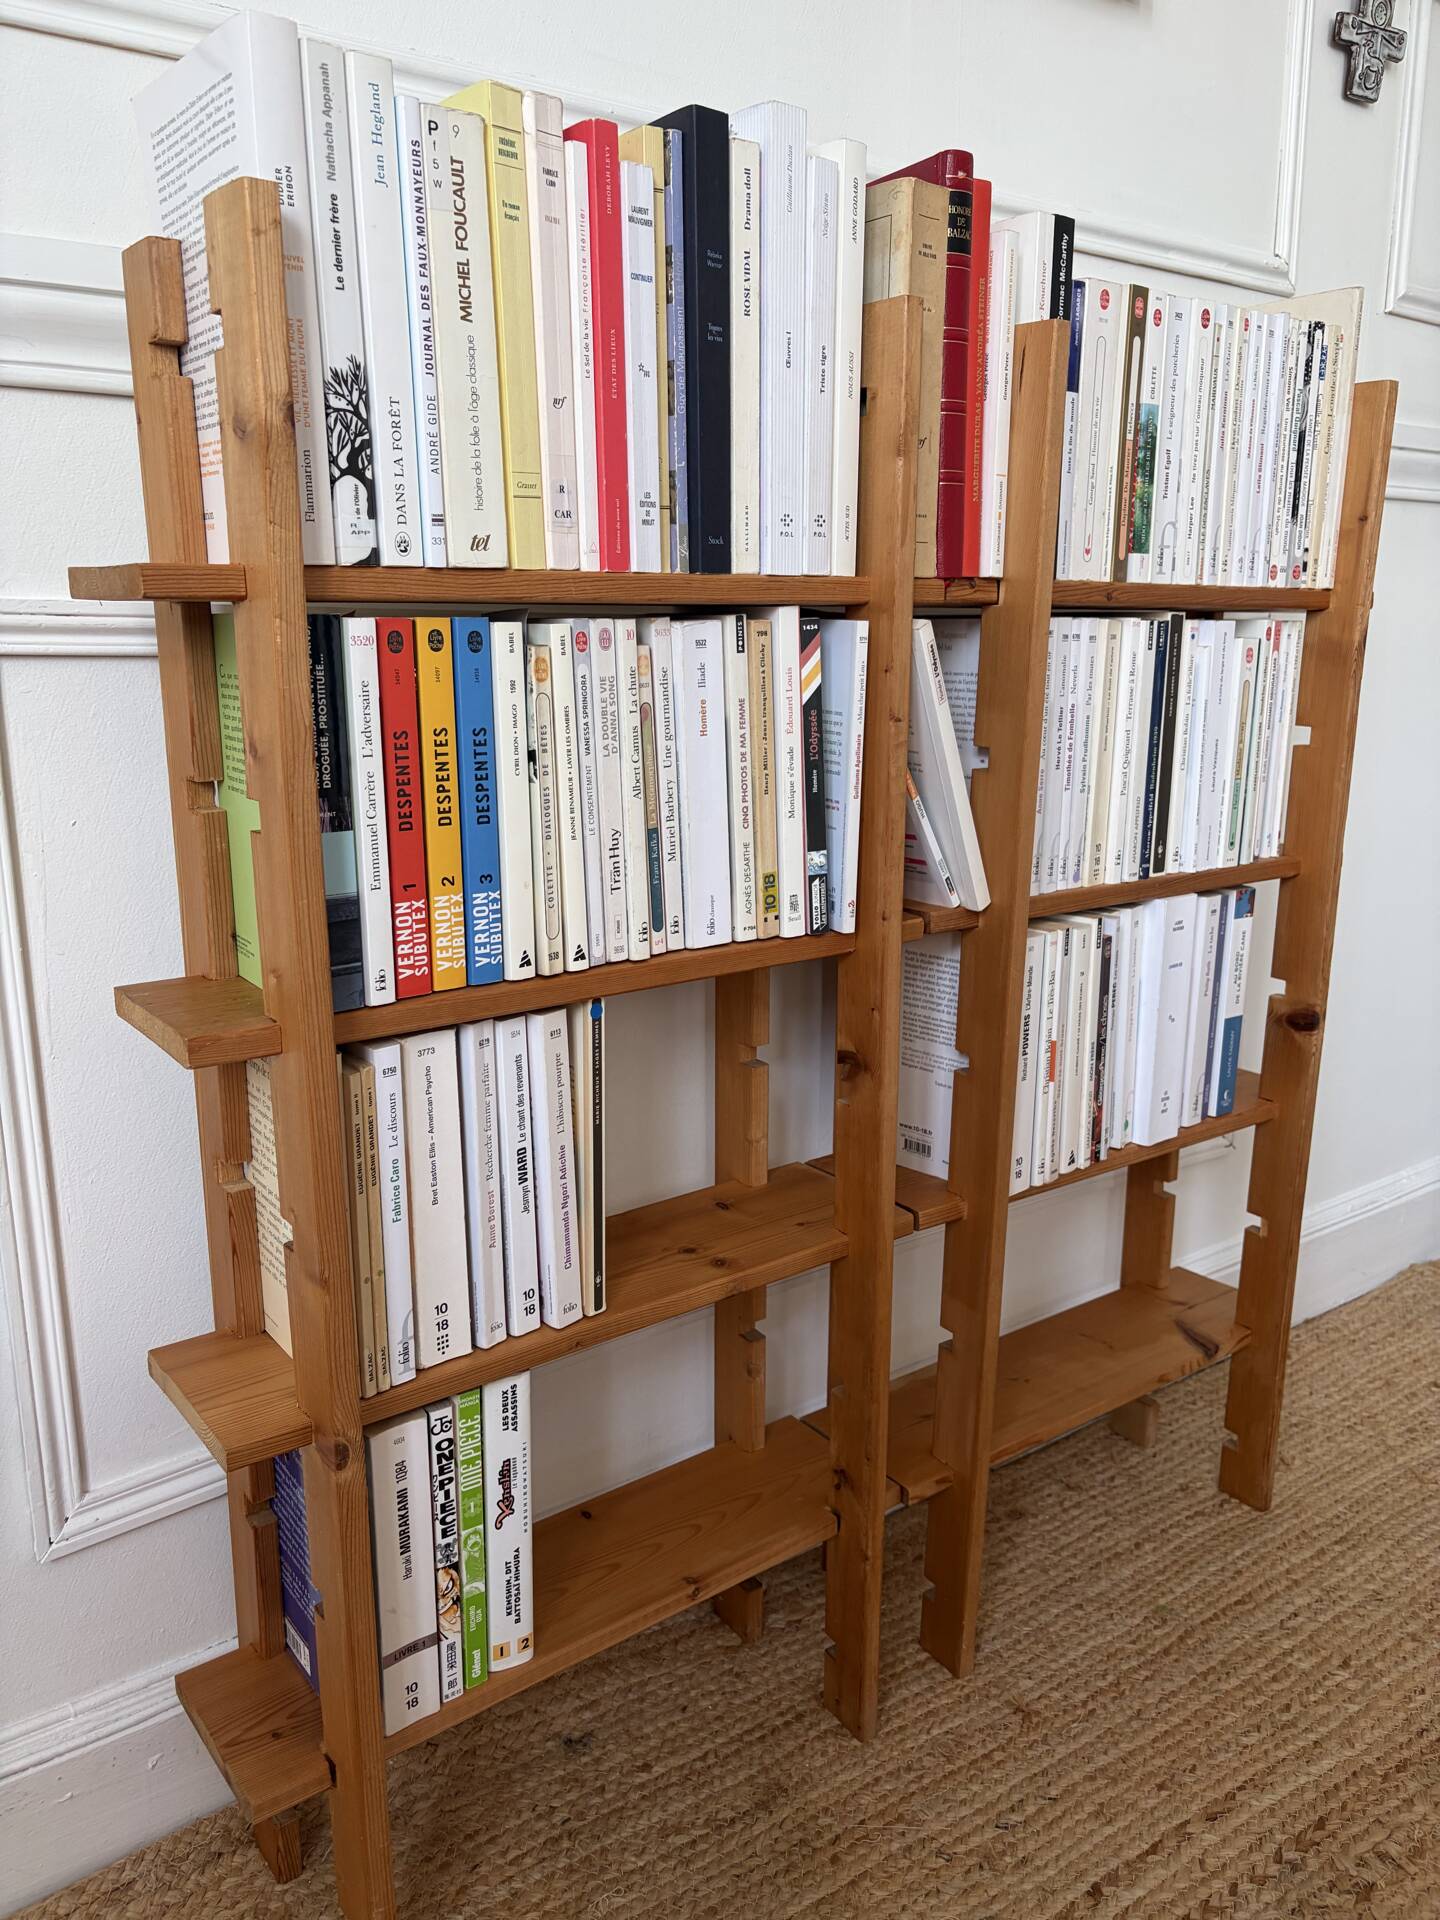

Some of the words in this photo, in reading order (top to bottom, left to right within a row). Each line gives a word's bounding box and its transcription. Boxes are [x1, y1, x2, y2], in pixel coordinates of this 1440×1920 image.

[319, 63, 333, 118] Appanah
[369, 82, 384, 146] Hegland
[323, 122, 337, 181] Nathacha
[285, 165, 295, 207] ERIBON
[374, 155, 388, 188] Jean
[329, 194, 340, 223] frère
[411, 139, 428, 278] FAUX-MONNAYEURS
[450, 156, 469, 251] FOUCAULT
[331, 228, 344, 272] dernier
[743, 248, 751, 282] VIDAL
[1059, 233, 1069, 281] McCarthy
[335, 276, 344, 290] Le
[420, 285, 431, 310] DES
[457, 258, 473, 323] MICHEL
[580, 258, 589, 313] Françoise
[743, 285, 751, 317] ROSE
[421, 317, 434, 377] JOURNAL
[583, 332, 589, 340] la
[583, 342, 590, 352] de
[675, 306, 686, 373] Maupassant
[465, 334, 478, 384] classique
[583, 354, 591, 367] Sel
[584, 369, 591, 379] Le
[677, 377, 685, 390] de
[426, 394, 436, 425] GIDE
[470, 415, 479, 423] à
[677, 393, 685, 414] Guy
[388, 396, 403, 450] FORÊT
[469, 426, 480, 446] folie
[393, 457, 404, 477] LA
[428, 431, 441, 474] ANDRÉ
[471, 449, 481, 459] la
[472, 461, 482, 475] de
[301, 449, 315, 523] Flammarion
[473, 478, 484, 511] histoire
[395, 483, 407, 525] DANS
[470, 534, 492, 552] tel
[350, 635, 375, 646] 3520
[317, 654, 328, 729] PROSTITUÉE...
[599, 675, 607, 694] VIE
[608, 675, 616, 706] SONG
[628, 666, 637, 697] chute
[697, 661, 707, 688] Iliade
[785, 666, 793, 692] Louis
[359, 680, 374, 759] L'adversaire
[601, 697, 610, 741] DOUBLE
[629, 699, 638, 714] La
[660, 666, 674, 742] gourmandise
[699, 699, 708, 737] Homère
[738, 697, 746, 729] FEMME
[785, 696, 794, 734] Édouard
[539, 724, 548, 753] BÊTES
[583, 722, 591, 756] VANESSA
[609, 710, 618, 753] D'ANNA
[631, 725, 641, 763] Camus
[739, 732, 747, 748] MA
[808, 709, 819, 760] L'Odyssée
[319, 733, 332, 789] DROGUÉE,
[603, 745, 610, 757] LA
[663, 745, 672, 768] Une
[739, 750, 747, 762] DE
[393, 731, 414, 831] DESPENTES
[433, 728, 453, 826] DESPENTES
[472, 727, 491, 825] DESPENTES
[542, 764, 548, 776] DE
[632, 767, 643, 800] Albert
[738, 764, 749, 803] PHOTOS
[366, 771, 378, 820] Carrère
[585, 765, 595, 825] CONSENTEMENT
[666, 778, 675, 822] Barbery
[543, 786, 551, 840] DIALOGUES
[741, 805, 749, 829] CINQ
[588, 827, 595, 836] LE
[608, 828, 621, 859] Huy
[651, 833, 659, 857] Kafka
[666, 826, 677, 862] Muriel
[367, 823, 382, 891] Emmanuel
[743, 842, 751, 883] DESARTHE
[403, 883, 417, 892] 1
[442, 875, 454, 887] 2
[480, 874, 492, 884] 3
[609, 860, 621, 895] Tran
[744, 884, 753, 914] AGNÈS
[395, 901, 415, 980] VERNON
[412, 899, 429, 976] SUBUTEX
[433, 894, 453, 971] VERNON
[450, 892, 466, 969] SUBUTEX
[472, 892, 490, 967] VERNON
[489, 890, 503, 964] SUBUTEX
[375, 969, 387, 992] folio
[1021, 1013, 1031, 1056] POWERS
[417, 1047, 435, 1058] 3773
[553, 1052, 564, 1088] pourpre
[424, 1065, 433, 1095] Psycho
[482, 1062, 493, 1097] parfaite
[514, 1054, 524, 1091] revenants
[388, 1092, 398, 1131] discours
[427, 1097, 435, 1134] American
[483, 1100, 492, 1132] femme
[516, 1103, 526, 1130] chant
[556, 1090, 565, 1134] L'hibiscus
[388, 1133, 399, 1148] Le
[428, 1142, 436, 1158] Ellis
[517, 1131, 527, 1143] Le
[389, 1158, 400, 1182] Caro
[429, 1160, 438, 1187] Easton
[484, 1134, 495, 1181] Recherche
[516, 1147, 528, 1183] WARD
[557, 1145, 567, 1180] Adichie
[391, 1184, 402, 1223] Fabrice
[431, 1189, 439, 1205] Bret
[521, 1185, 531, 1214] Jesmyn
[559, 1182, 570, 1208] Ngozi
[561, 1210, 572, 1270] Chimamanda
[510, 1384, 518, 1432] ASSASSINS
[459, 1415, 481, 1459] PIECE
[395, 1460, 407, 1483] 1Q84
[396, 1488, 412, 1556] MURAKAMI
[402, 1555, 413, 1580] Haruki
[505, 1576, 513, 1616] KENSHIN,
[513, 1583, 521, 1624] BATTOSAÏ
[472, 1649, 482, 1678] Glénat
